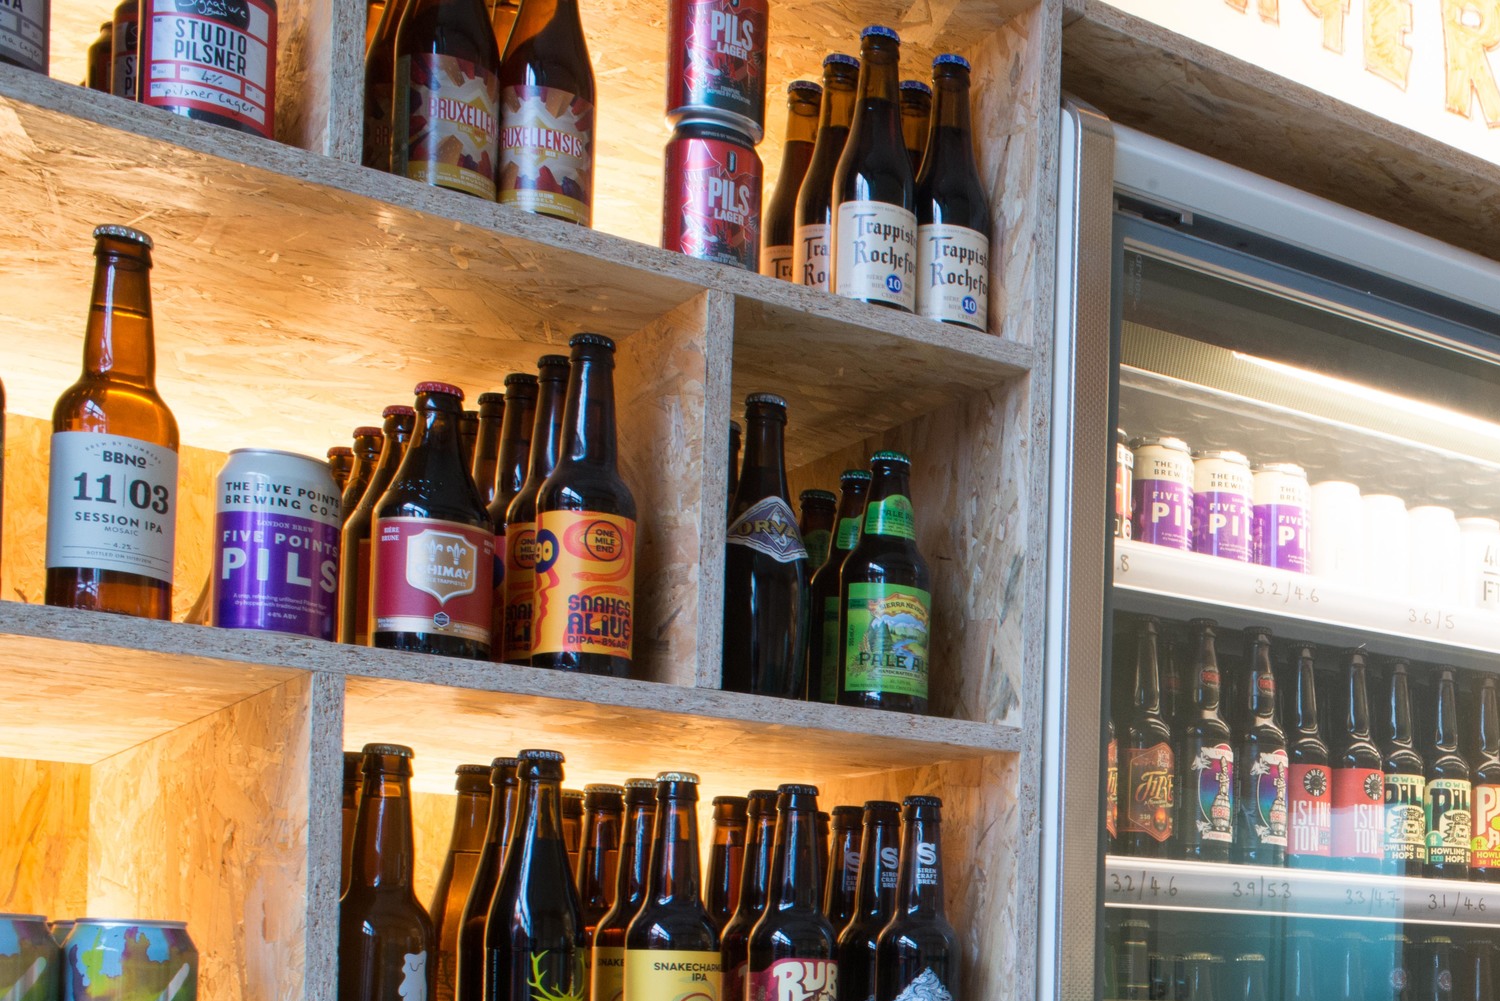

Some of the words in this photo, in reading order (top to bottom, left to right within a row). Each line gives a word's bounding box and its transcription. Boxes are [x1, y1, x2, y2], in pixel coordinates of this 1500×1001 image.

[175, 18, 248, 56] STUDIO
[710, 10, 754, 52] PILS
[174, 38, 248, 77] PILSNER
[717, 41, 749, 61] LAGER
[708, 175, 751, 217] PILS
[714, 207, 745, 227] LAGER
[887, 276, 901, 291] 10
[963, 298, 976, 313] 10
[129, 478, 169, 515] 03
[225, 494, 301, 511] BREWING
[226, 481, 250, 492] THE
[256, 482, 292, 496] FIVE
[298, 487, 340, 509] POINTS
[1153, 491, 1179, 502] FIVE
[1209, 503, 1236, 514] FIVE
[75, 511, 140, 529] SESSION
[145, 520, 163, 535] IPA
[104, 525, 139, 537] MOSAIC
[595, 528, 615, 539] ONE
[595, 536, 616, 547] MILE
[223, 529, 264, 544] FIVE
[275, 534, 338, 559] POINTS
[596, 545, 615, 555] END
[221, 547, 337, 594] PILS
[567, 594, 631, 617] SNAKES
[567, 613, 631, 641] ALIVE
[858, 651, 908, 669] PALE
[1430, 847, 1465, 857] HOWLING
[1444, 854, 1465, 864] HOPS
[691, 972, 708, 982] IPA
